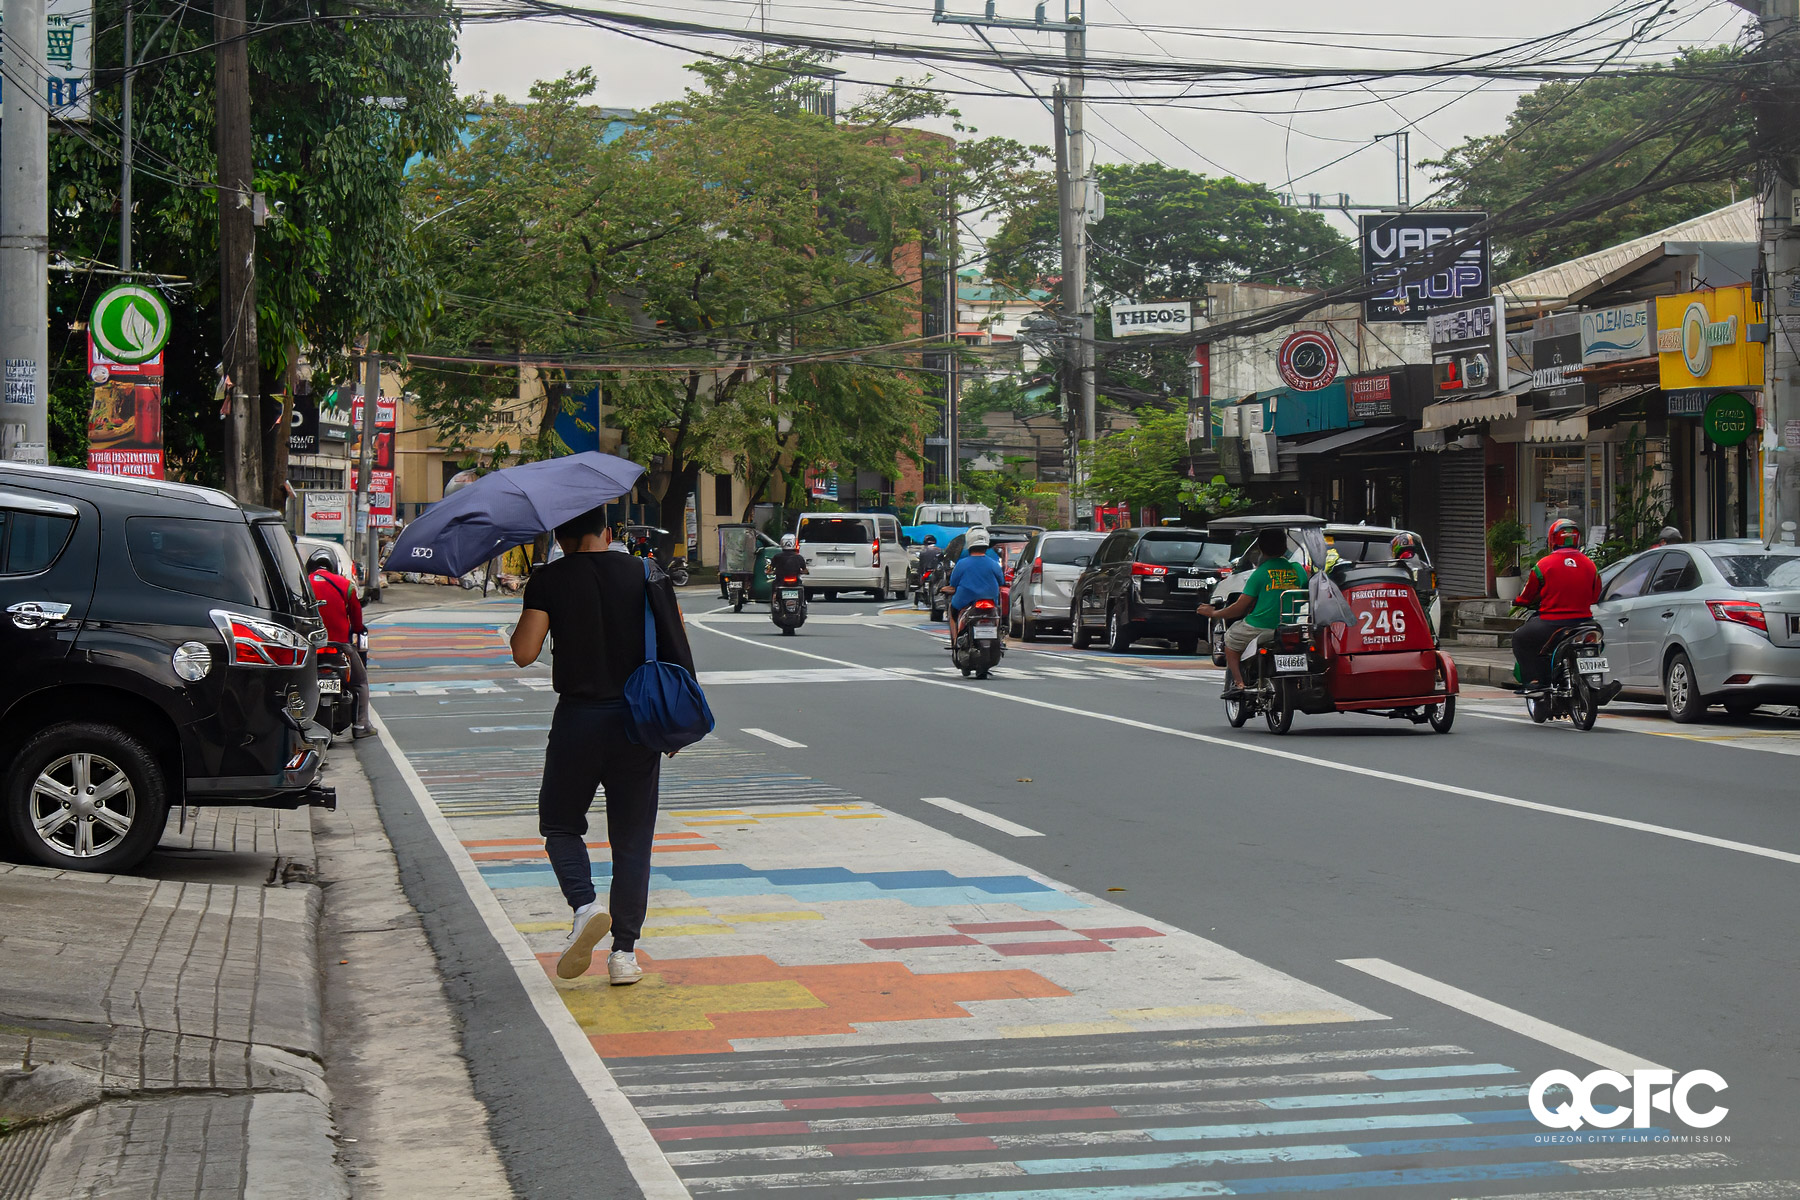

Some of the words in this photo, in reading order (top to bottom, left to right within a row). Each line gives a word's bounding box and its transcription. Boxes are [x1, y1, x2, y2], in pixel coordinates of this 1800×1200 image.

[1370, 265, 1483, 301] SHOP
[1116, 309, 1187, 326] THEO'S
[1359, 610, 1406, 634] 246
